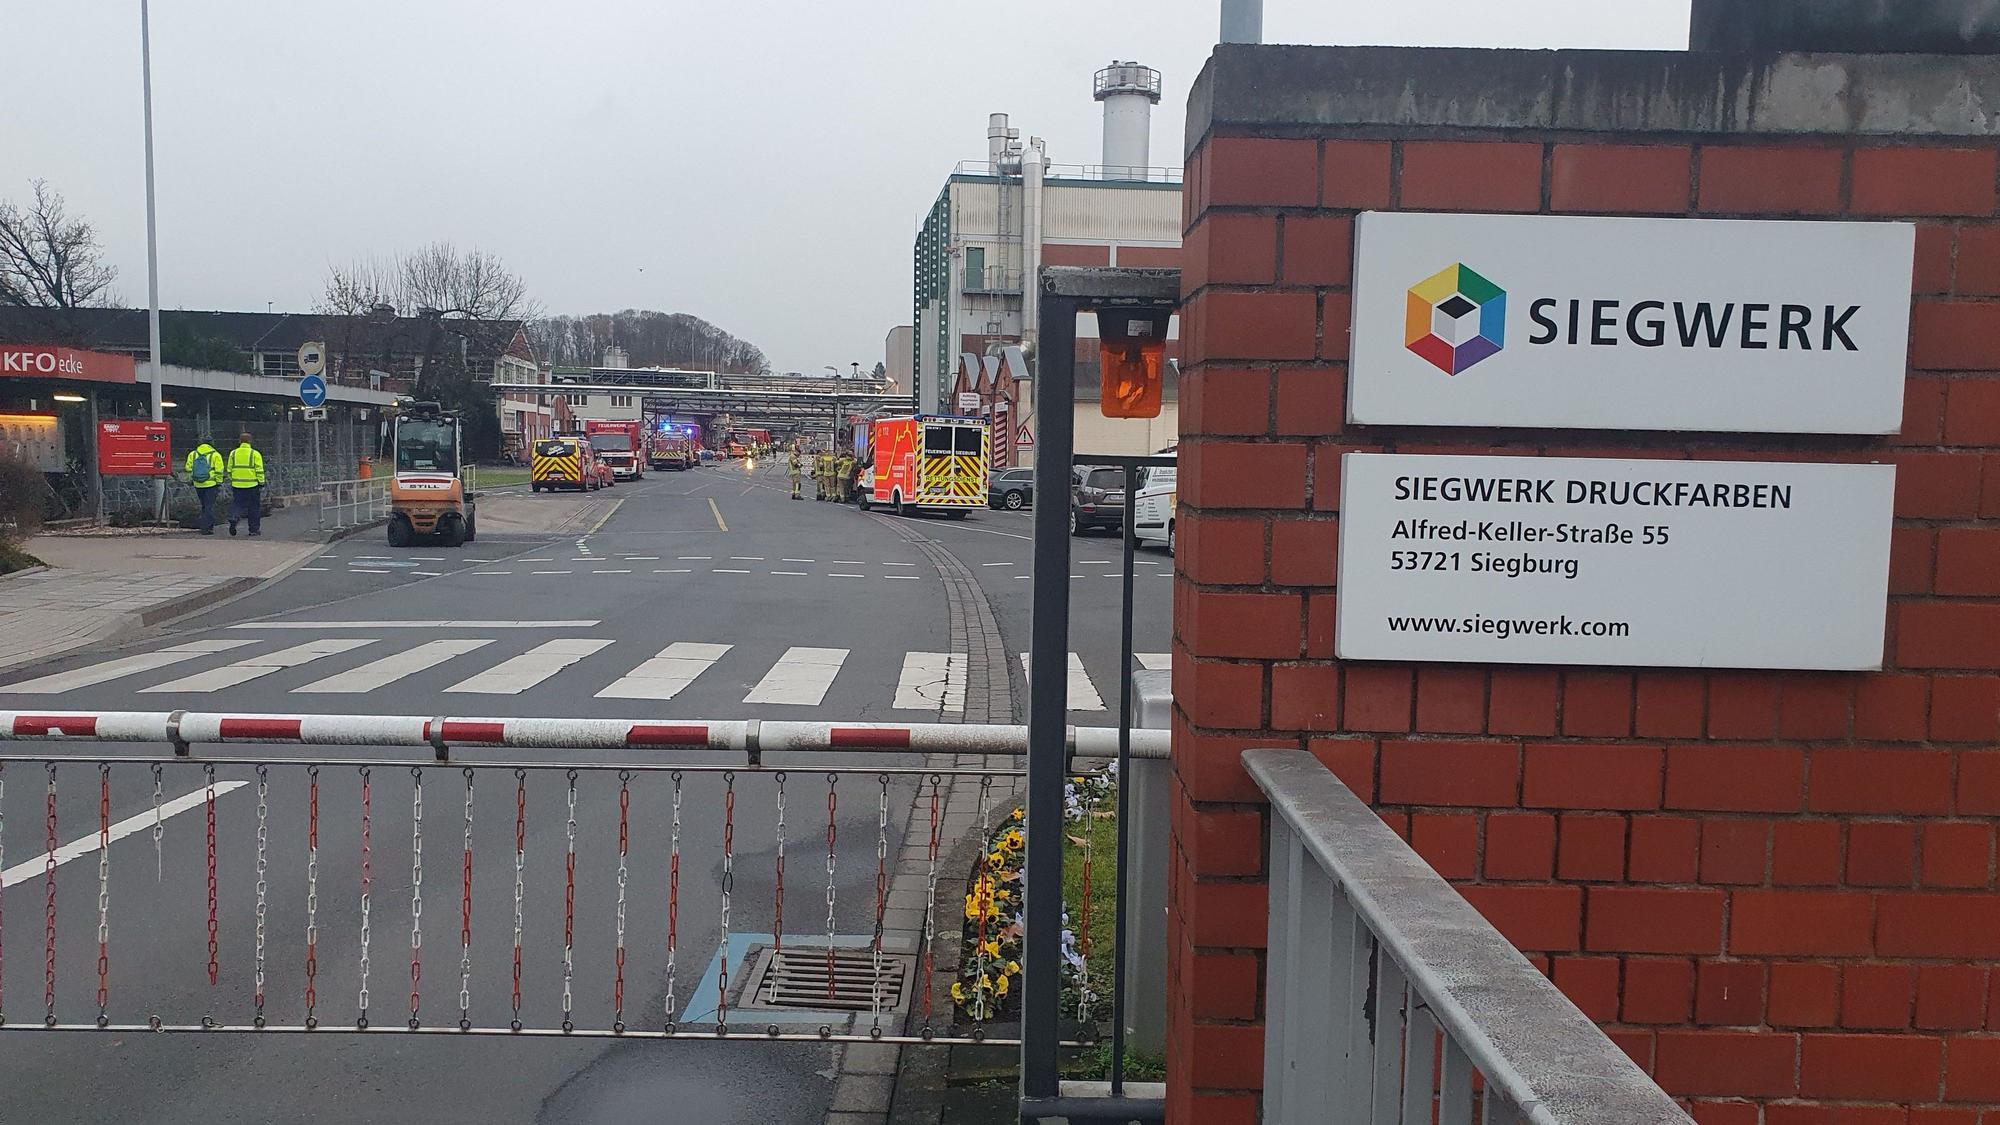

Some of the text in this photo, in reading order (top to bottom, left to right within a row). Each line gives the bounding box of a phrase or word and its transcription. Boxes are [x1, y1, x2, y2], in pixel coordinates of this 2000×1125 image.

[1528, 297, 1862, 352] SIEGWERK
[0, 351, 83, 374] KFO ecke
[1394, 476, 1792, 509] SIEGWERK DRUCKFARBEN
[1391, 518, 1669, 545] Alfred-Keller-Straße 55
[1391, 550, 1579, 580] 53721 Siegburg
[1387, 613, 1629, 640] www.siegwerk.com
